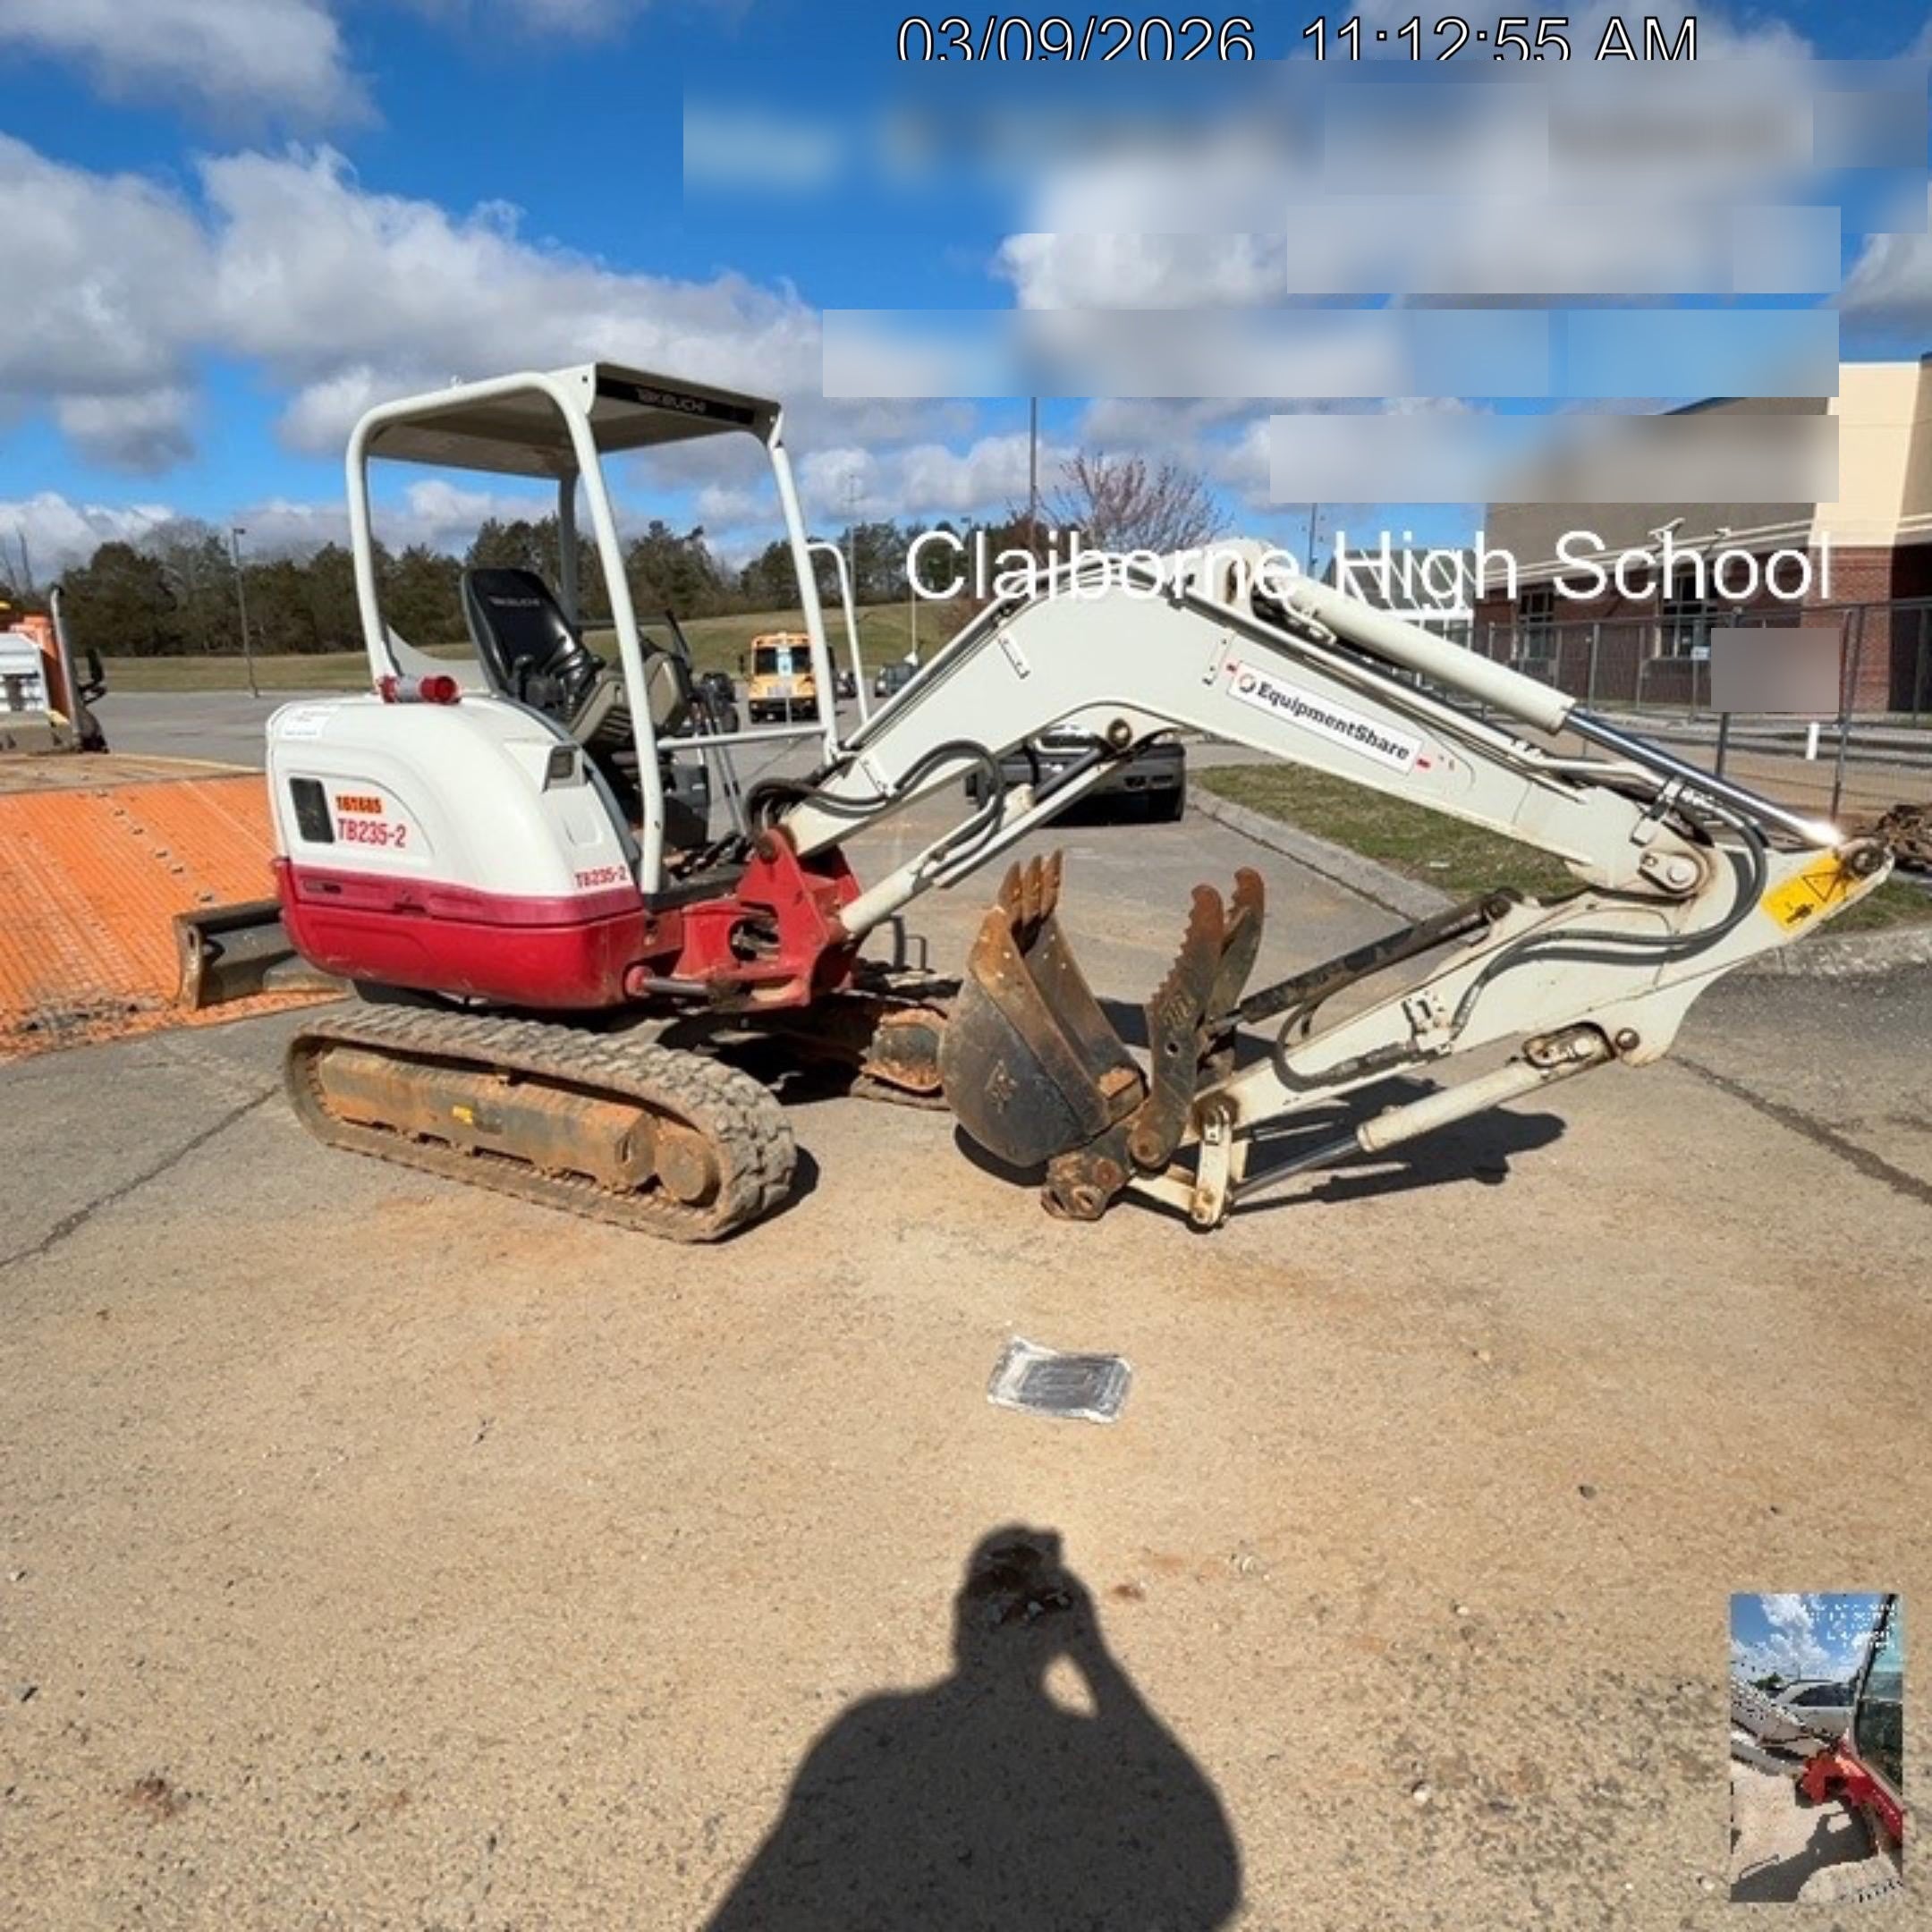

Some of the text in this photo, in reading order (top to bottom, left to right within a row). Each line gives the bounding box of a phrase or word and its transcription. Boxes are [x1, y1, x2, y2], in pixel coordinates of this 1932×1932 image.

[1256, 681, 1411, 760] EquipmentShare
[337, 818, 407, 849] TB235-2
[574, 864, 629, 888] TB235-2
